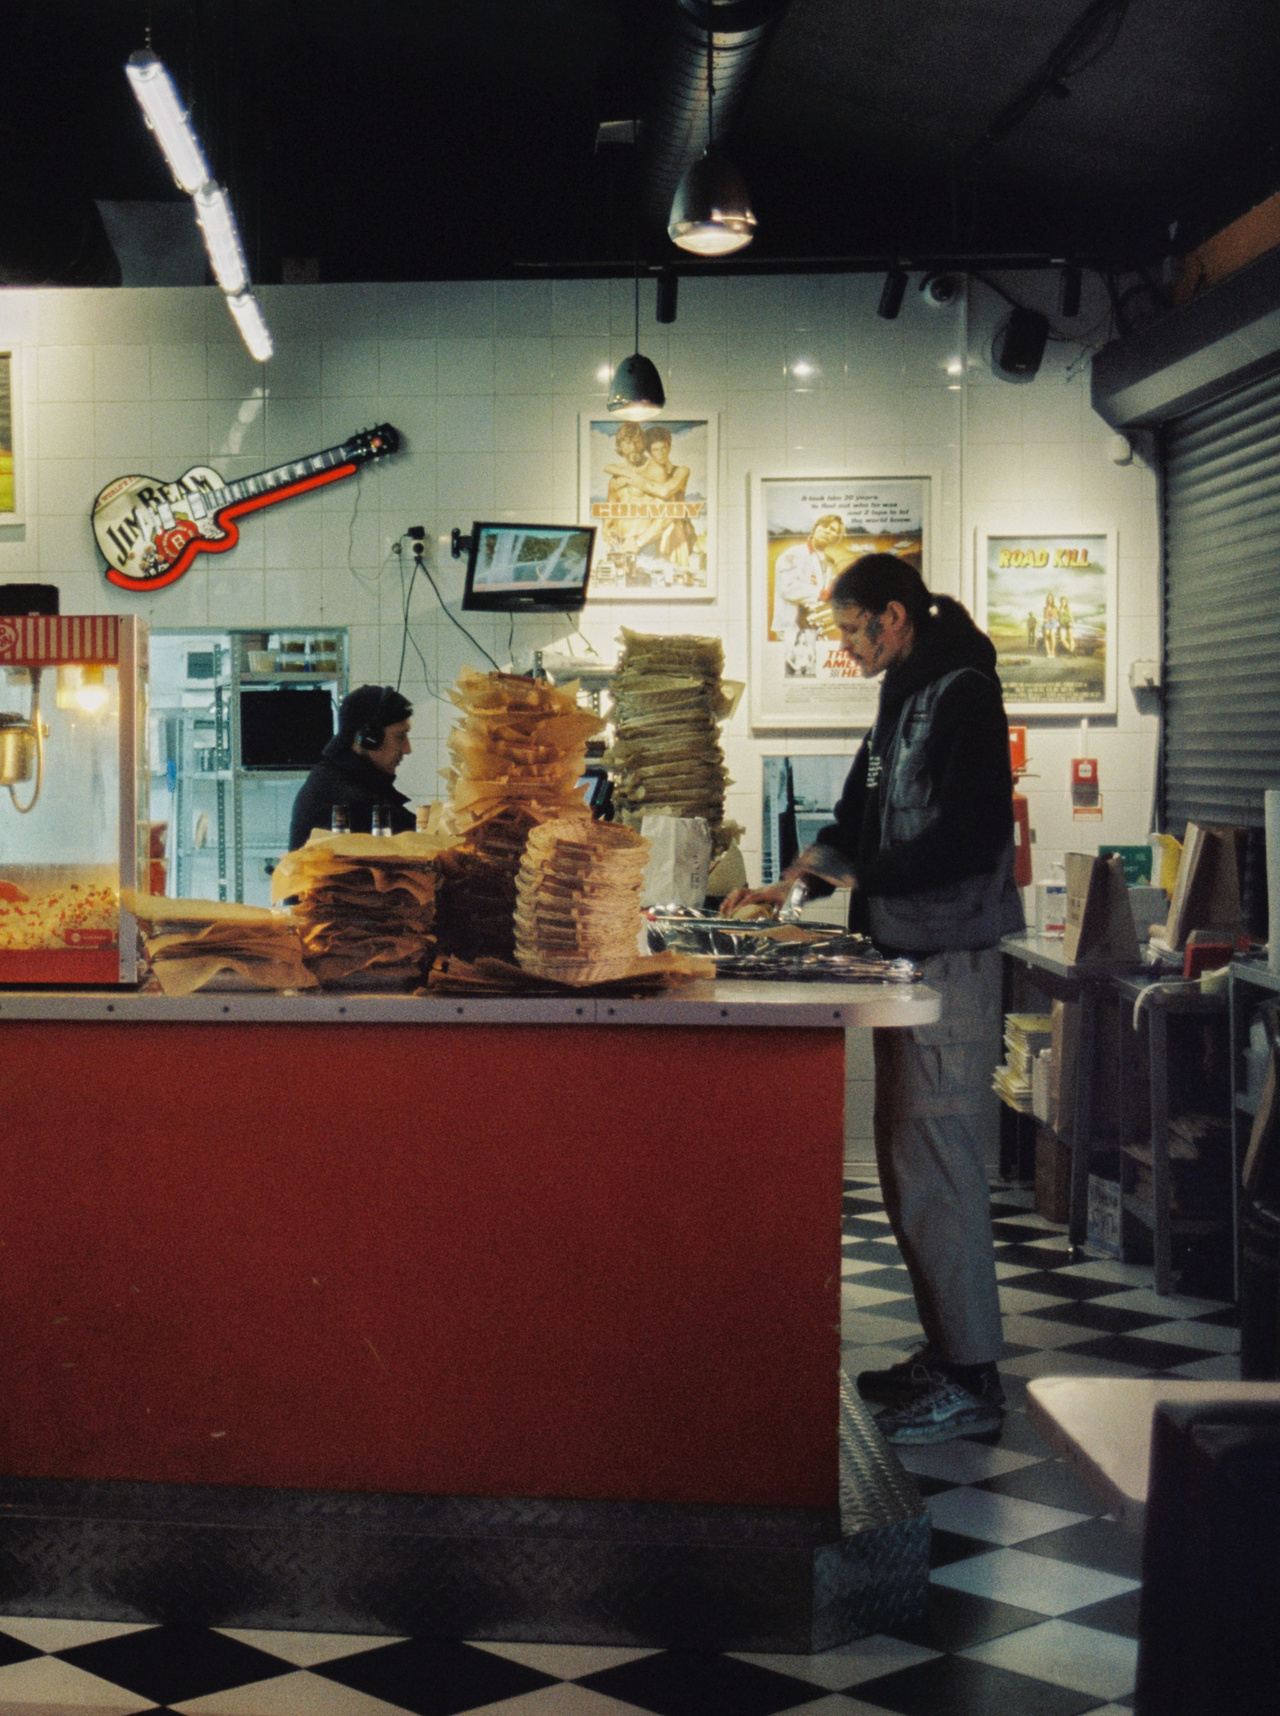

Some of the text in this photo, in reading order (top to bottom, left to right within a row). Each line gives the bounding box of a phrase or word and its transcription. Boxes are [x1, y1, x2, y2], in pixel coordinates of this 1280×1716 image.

[591, 502, 705, 518] CONVOY
[106, 505, 142, 566] JIM
[136, 475, 215, 513] BEAM
[171, 533, 186, 551] B
[998, 547, 1090, 569] ROAD KILL
